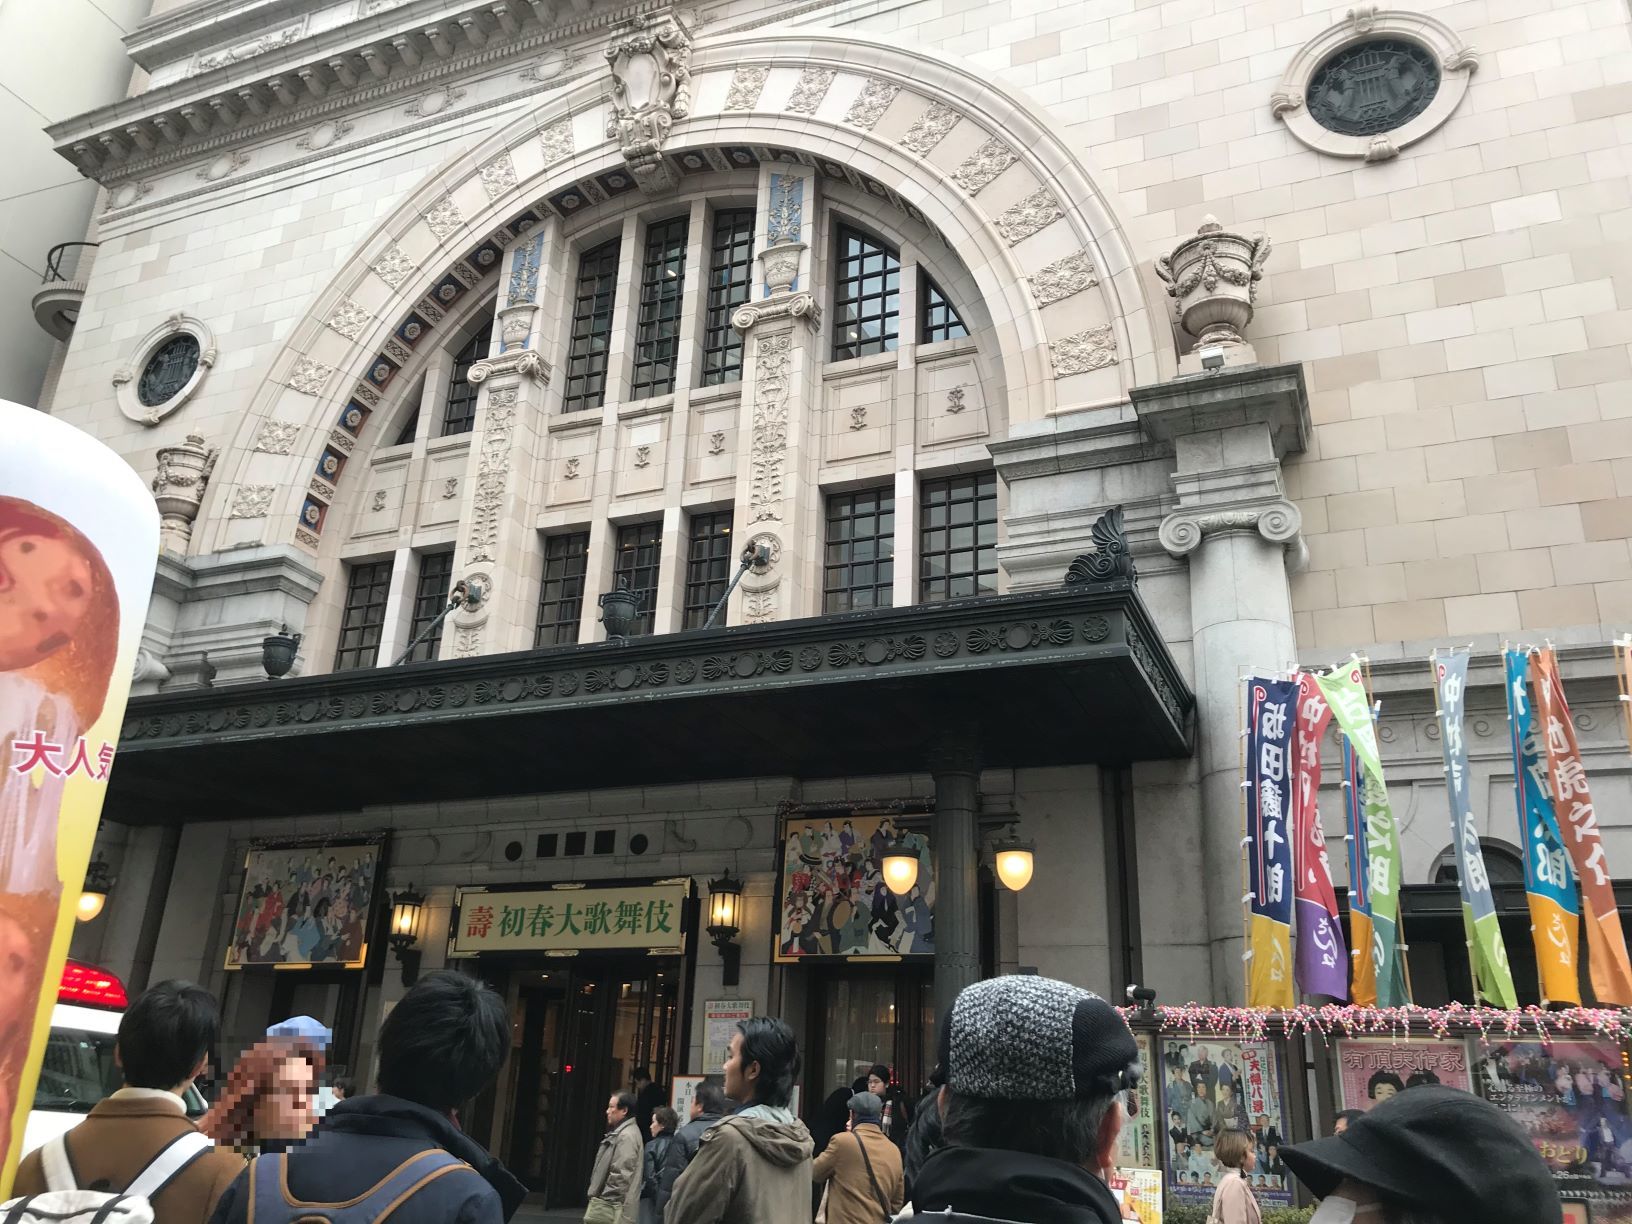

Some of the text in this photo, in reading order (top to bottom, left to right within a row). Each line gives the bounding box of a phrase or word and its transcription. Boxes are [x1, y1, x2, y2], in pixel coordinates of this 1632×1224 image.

[466, 899, 674, 938] 壽初春大歌舞伎
[1343, 1048, 1465, 1072] 有頂天作家
